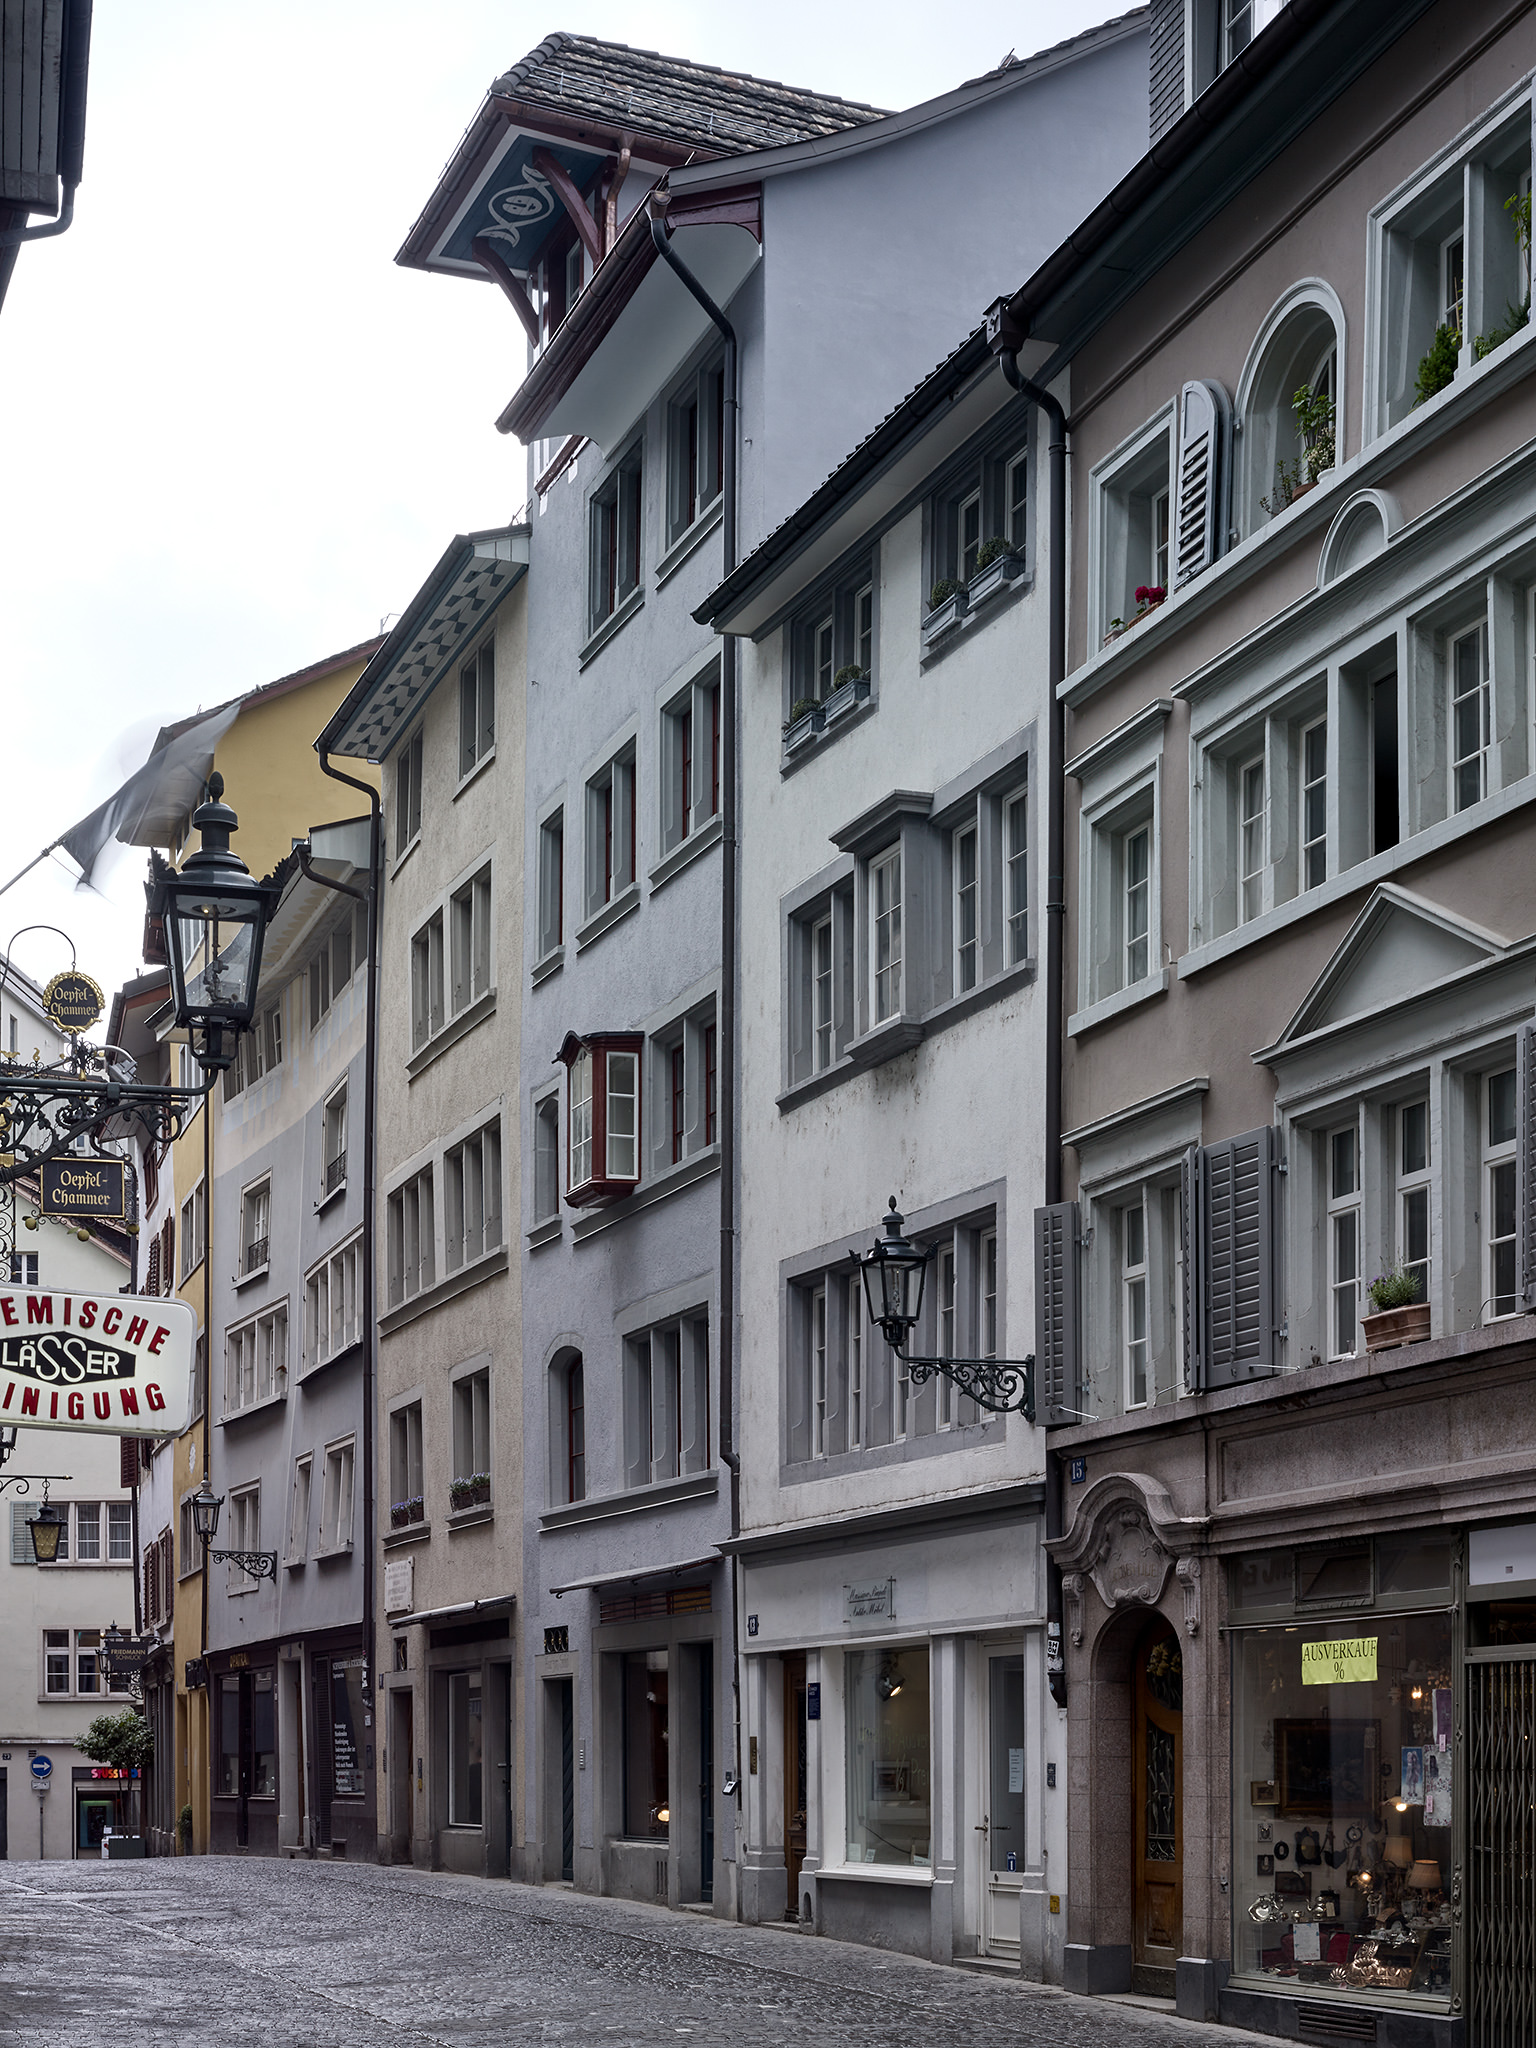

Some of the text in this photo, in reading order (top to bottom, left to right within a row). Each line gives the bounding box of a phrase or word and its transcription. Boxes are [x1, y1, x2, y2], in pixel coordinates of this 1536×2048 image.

[54, 986, 94, 1003] Oepfel-
[51, 1002, 97, 1017] Chammer
[60, 1169, 109, 1190] Oepfel-
[52, 1188, 112, 1207] Chammer
[0, 1295, 171, 1356] EMISCHE
[2, 1334, 121, 1383] LÄSSER
[2, 1382, 166, 1420] INIGUNG
[1072, 1461, 1083, 1480] 15
[1302, 1639, 1377, 1662] AUSVERKAUF
[1333, 1661, 1345, 1680] %
